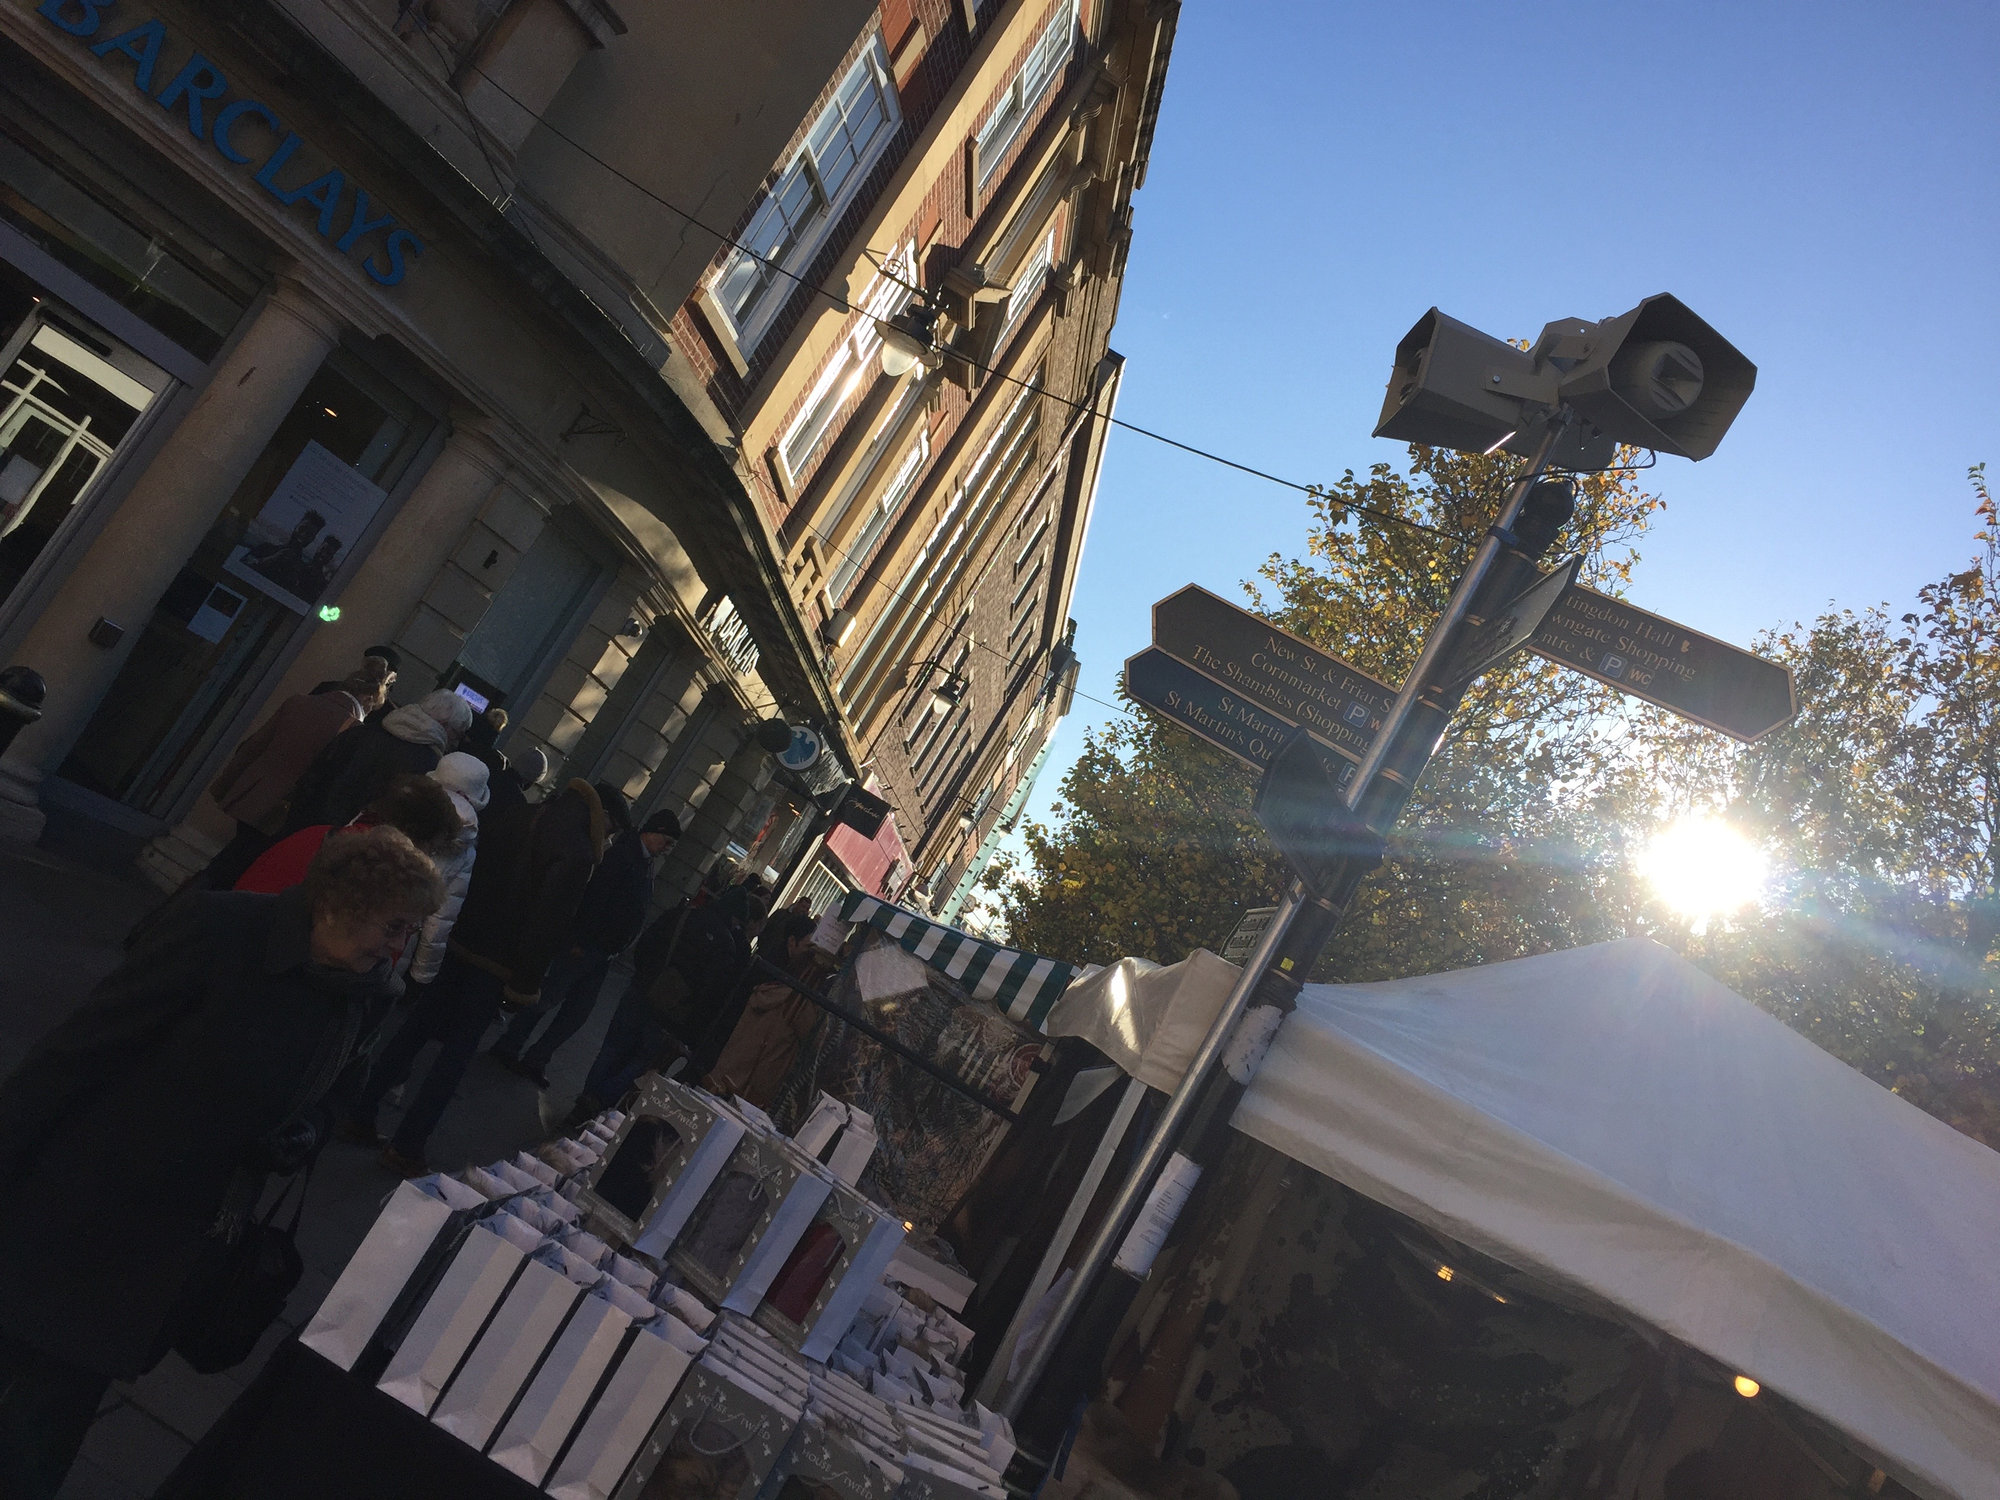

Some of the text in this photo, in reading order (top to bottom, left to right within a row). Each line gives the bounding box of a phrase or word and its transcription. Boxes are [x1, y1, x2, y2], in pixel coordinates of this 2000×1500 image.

[35, 0, 425, 286] BARCLAYS
[718, 609, 760, 674] BARCLAYS
[1552, 613, 1697, 681] wngate Shopping
[1566, 594, 1675, 647] tingdon Hall
[1264, 637, 1393, 713] New St. & Friar S
[1541, 633, 1575, 652] ntre
[1579, 646, 1596, 662] &
[1629, 668, 1652, 685] WC
[1165, 690, 1181, 709] St
[1183, 701, 1246, 745] Martin's
[1192, 644, 1370, 754] The Shambles (Shopping
[1218, 696, 1234, 714] St
[1236, 707, 1285, 744] Martin
[1251, 652, 1342, 712] Cornmarket
[1370, 717, 1382, 731] W
[697, 1392, 728, 1415] HOUSE
[740, 1418, 771, 1441] TWEED
[802, 1448, 873, 1499] HOUSE of TWEED
